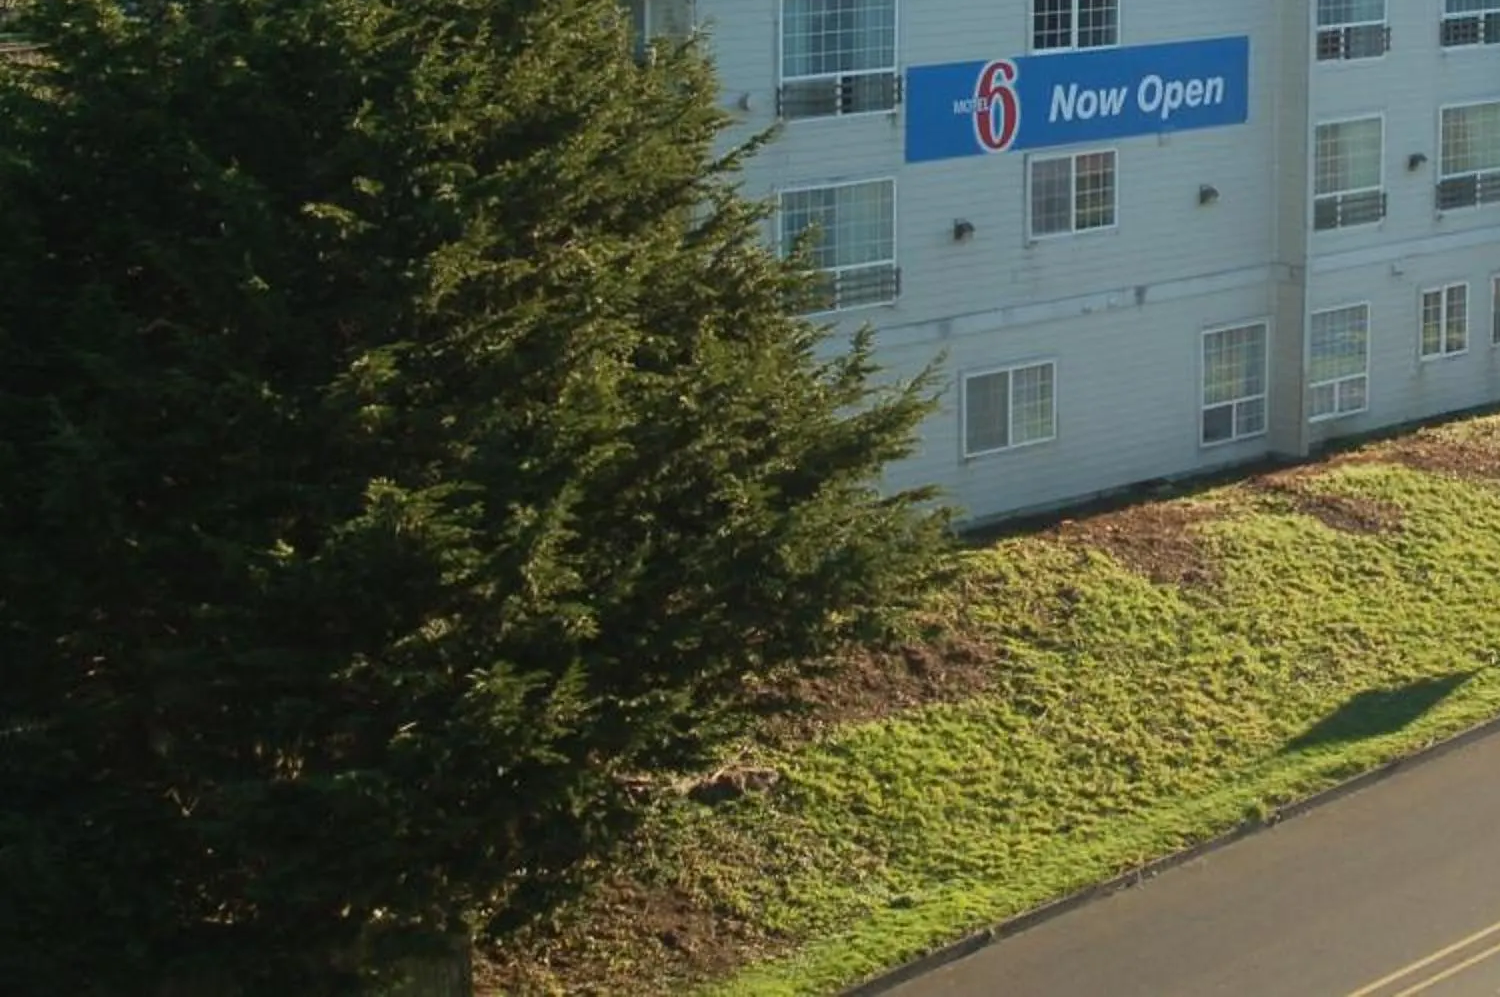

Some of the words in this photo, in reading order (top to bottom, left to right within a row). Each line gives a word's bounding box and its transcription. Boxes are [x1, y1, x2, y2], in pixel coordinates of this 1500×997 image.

[953, 97, 989, 114] MOTEL
[973, 59, 1021, 153] 6
[1049, 82, 1128, 123] Now
[1137, 74, 1225, 119] Open
